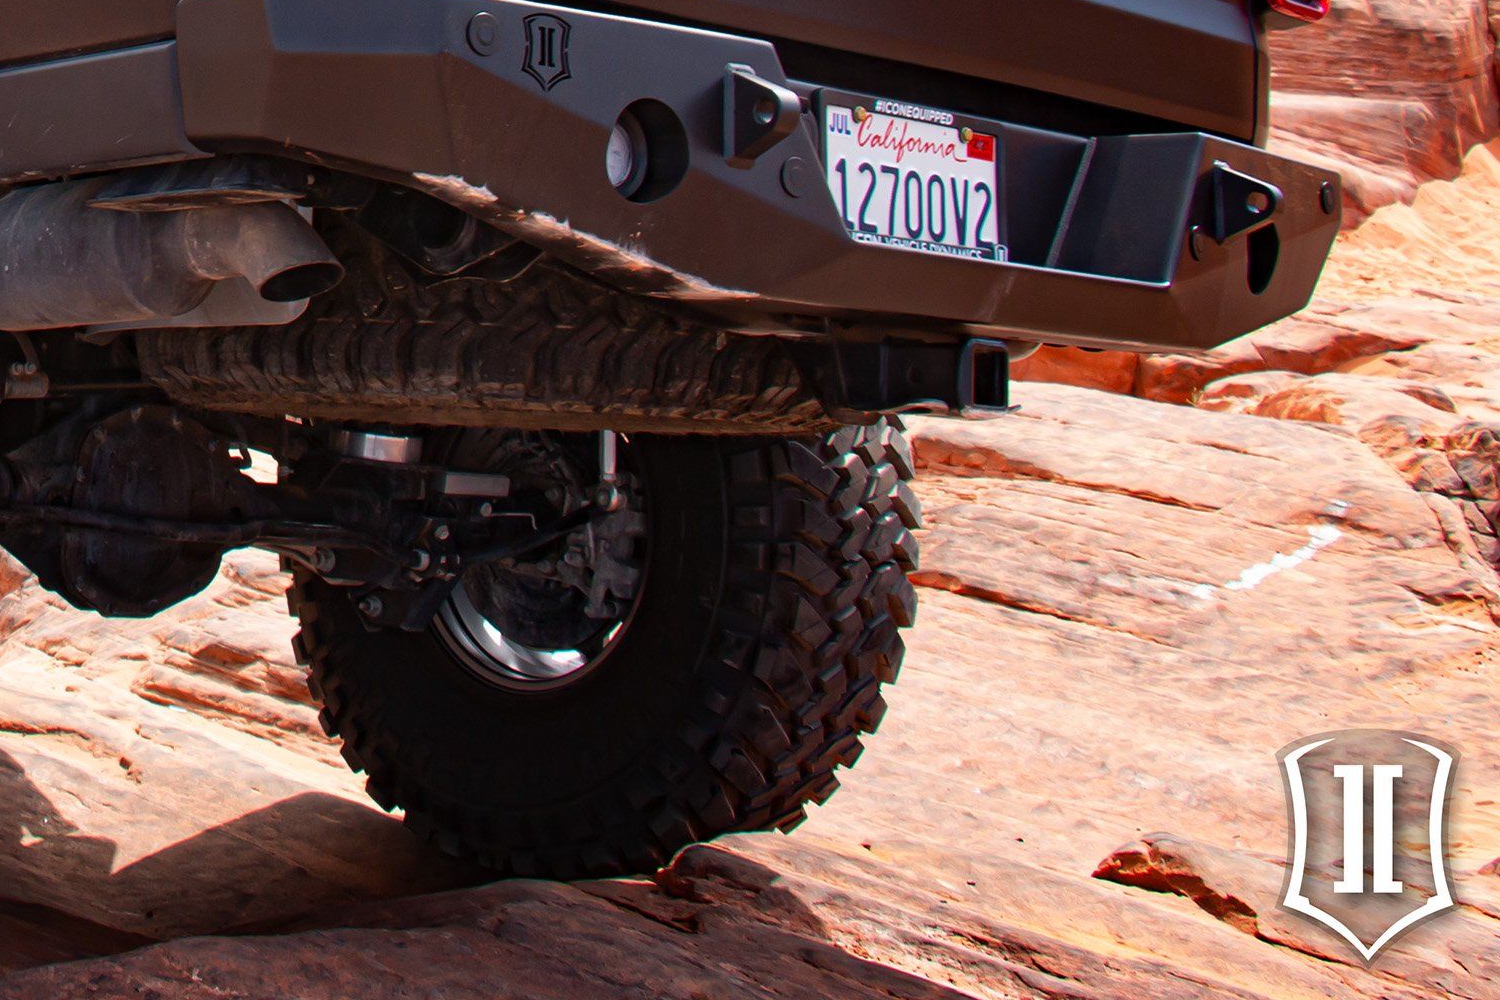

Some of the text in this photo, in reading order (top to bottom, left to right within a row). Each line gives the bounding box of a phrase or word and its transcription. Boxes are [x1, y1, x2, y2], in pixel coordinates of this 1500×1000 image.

[829, 112, 852, 135] JUL
[875, 100, 954, 126] #ICONEQUIPPED
[857, 113, 968, 163] California
[835, 157, 994, 250] 12700V2
